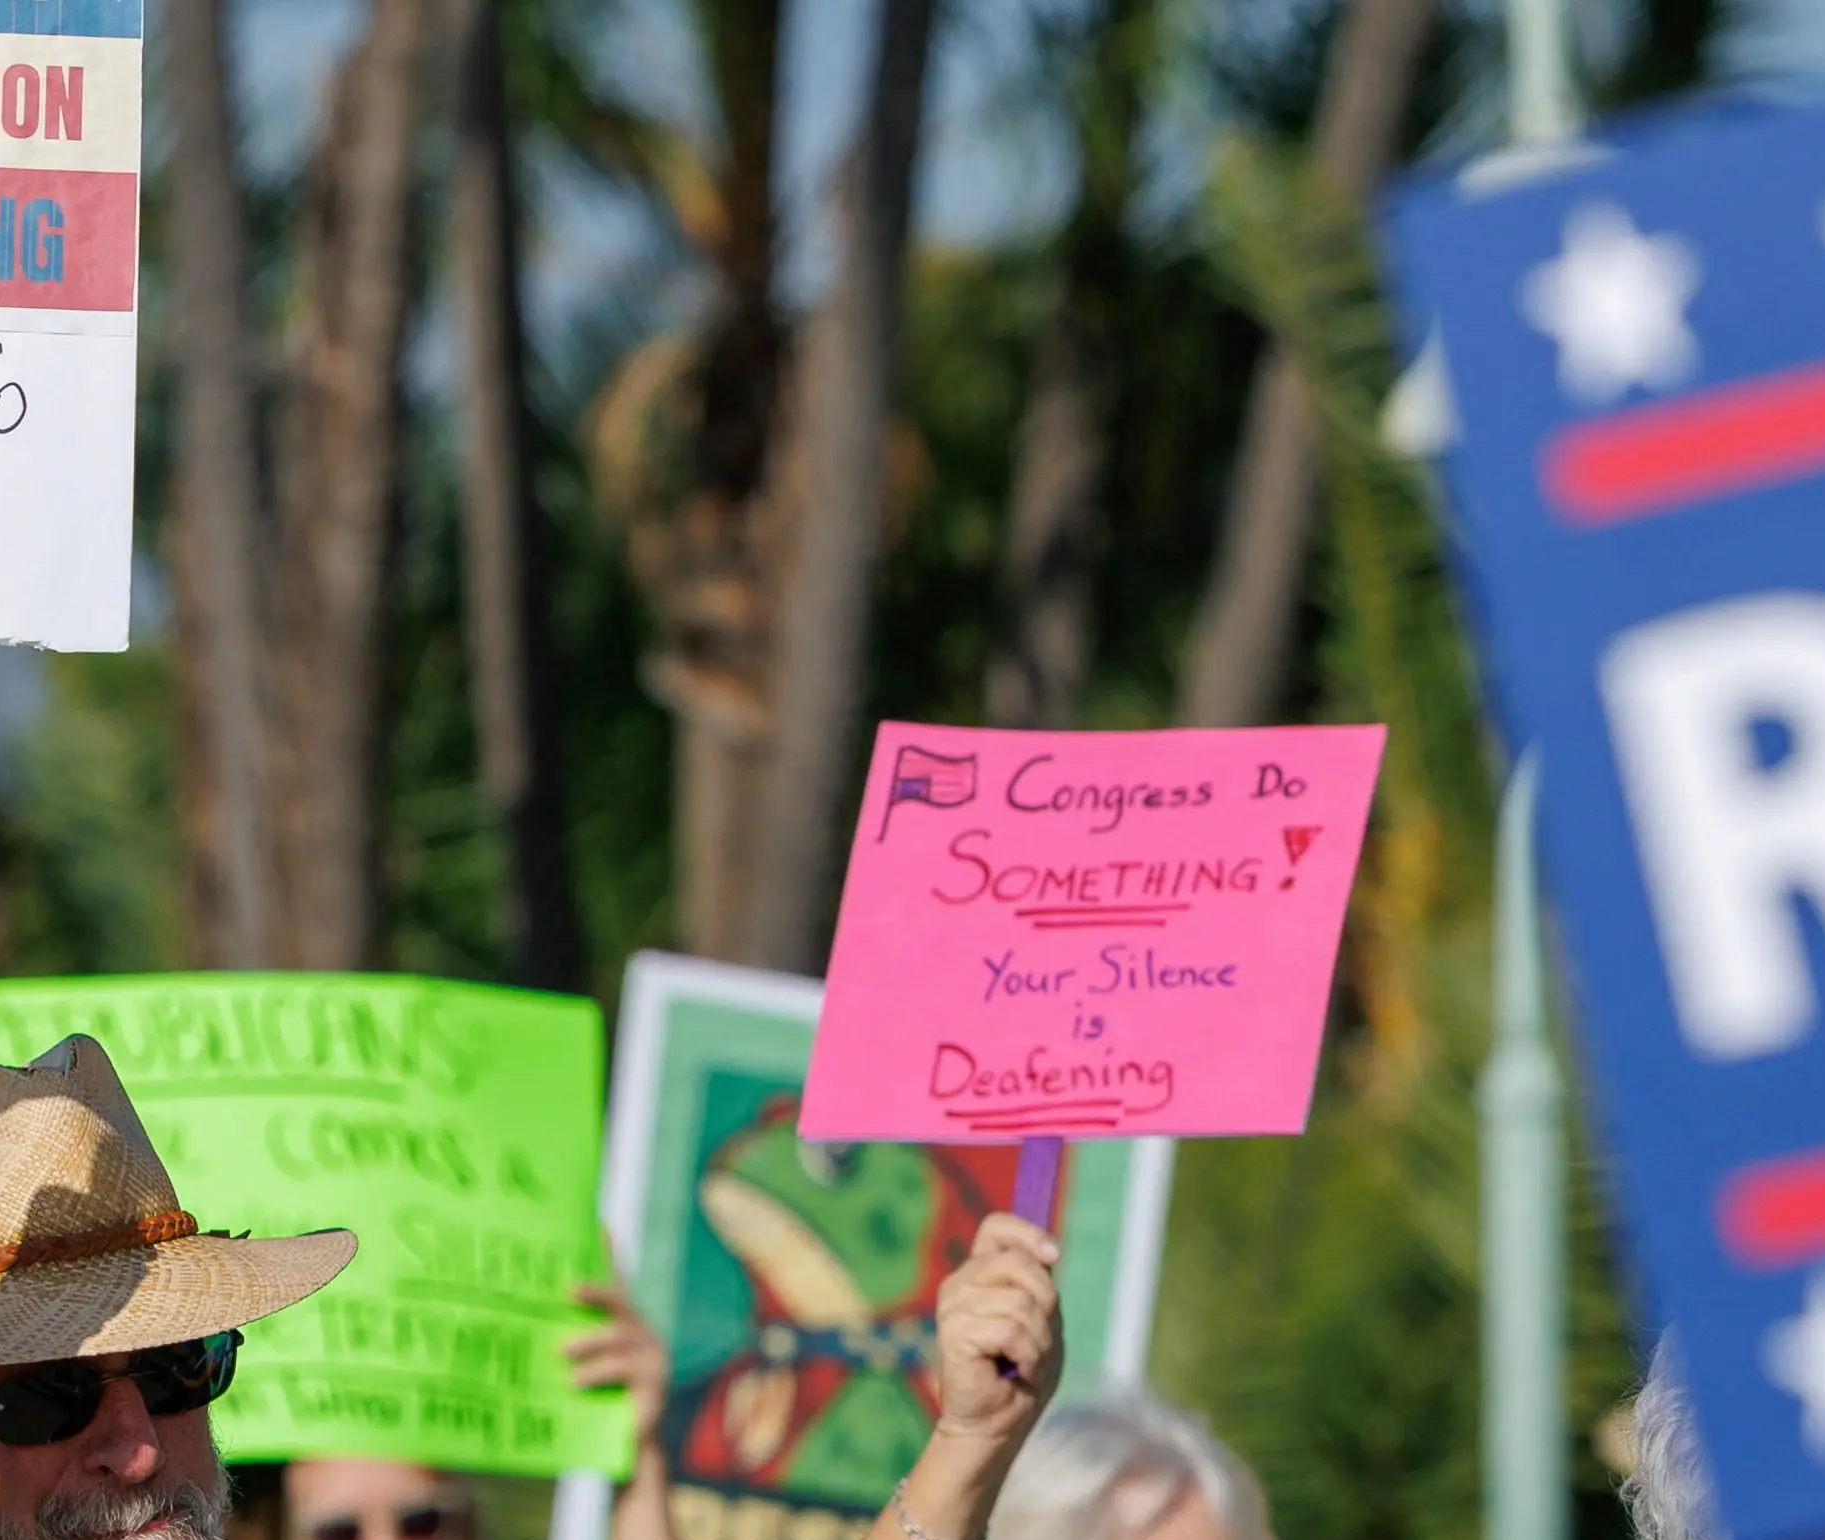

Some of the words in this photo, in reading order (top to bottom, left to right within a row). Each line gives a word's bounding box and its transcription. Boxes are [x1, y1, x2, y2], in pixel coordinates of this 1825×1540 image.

[1005, 753, 1215, 836] Congress
[1250, 763, 1308, 801] Do
[983, 951, 1078, 1002] Your
[1088, 943, 1239, 995] Silence
[1072, 1001, 1106, 1041] is
[929, 1043, 1175, 1114] Deafening
